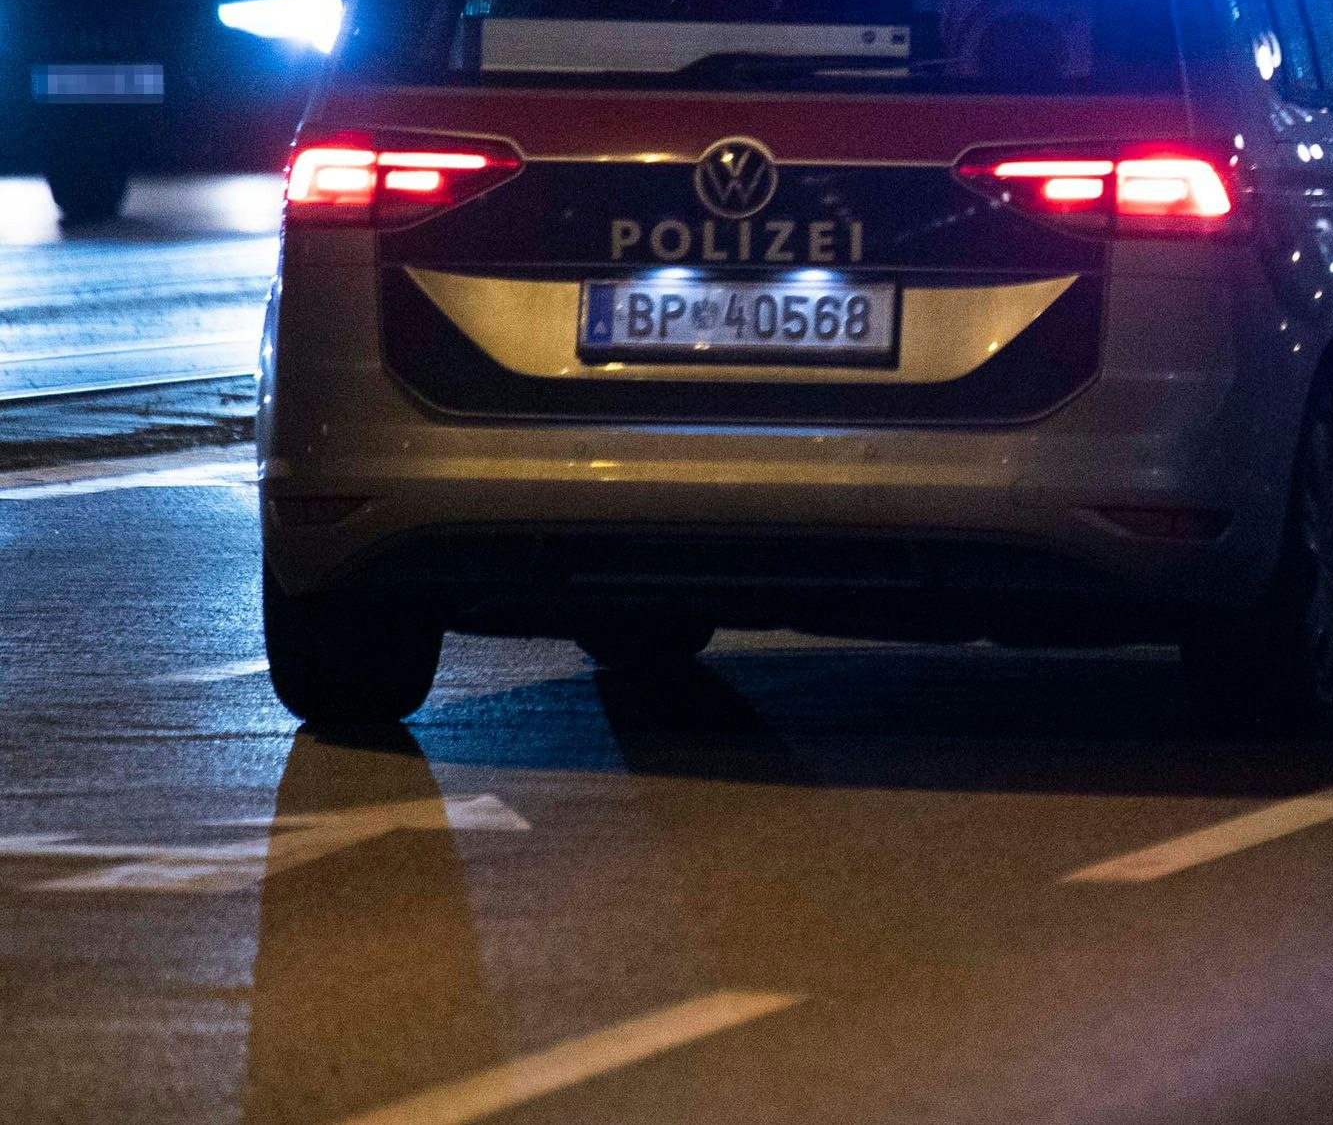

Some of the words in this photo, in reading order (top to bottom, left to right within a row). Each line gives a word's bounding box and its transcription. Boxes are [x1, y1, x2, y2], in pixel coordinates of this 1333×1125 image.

[611, 219, 864, 262] POLIZEI
[628, 292, 687, 339] BP
[725, 293, 872, 341] 40568
